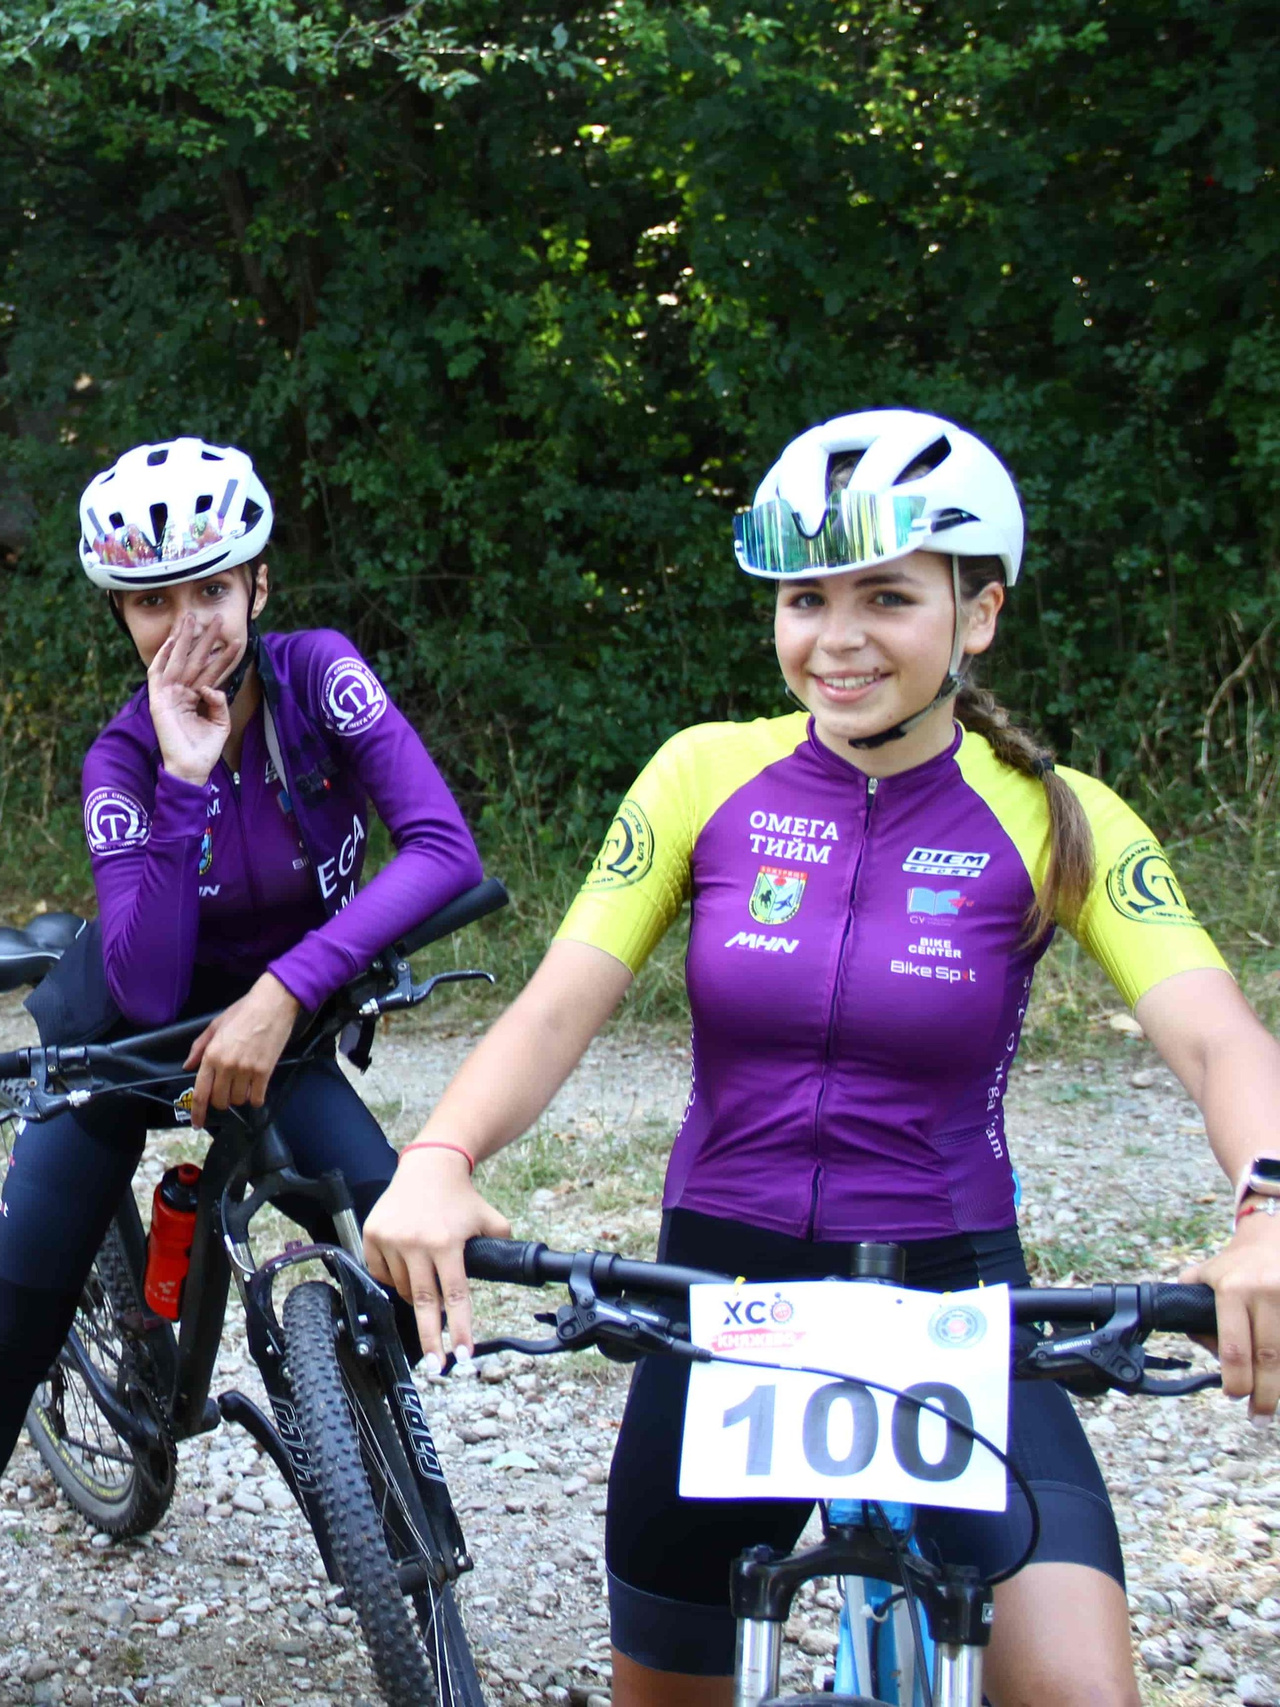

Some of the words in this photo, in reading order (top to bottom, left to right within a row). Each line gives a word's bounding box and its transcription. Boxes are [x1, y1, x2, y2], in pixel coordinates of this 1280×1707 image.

[749, 810, 839, 841] ОМЕГА
[749, 833, 832, 864] ТИЙМ
[912, 851, 985, 866] DIEM
[908, 944, 962, 958] CENTER
[920, 937, 952, 950] BIKE
[890, 959, 932, 978] Bike
[722, 1381, 974, 1482] 100
